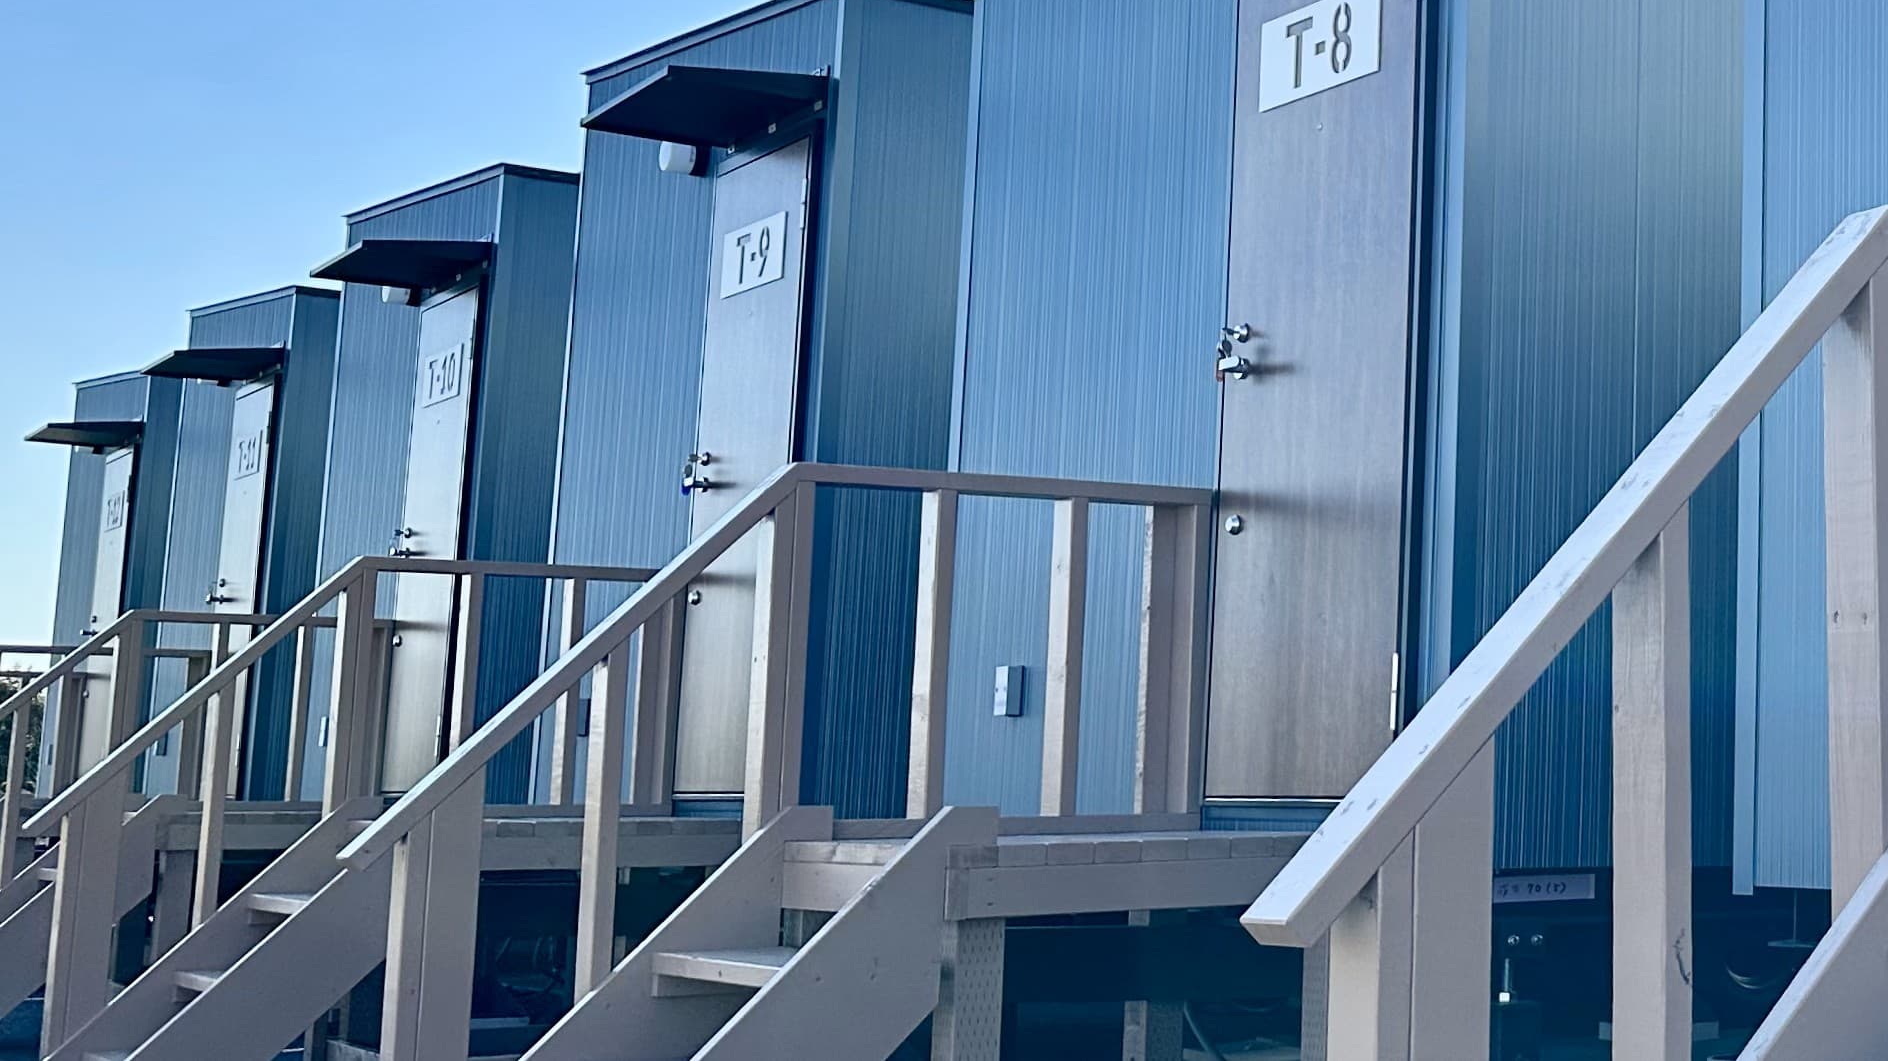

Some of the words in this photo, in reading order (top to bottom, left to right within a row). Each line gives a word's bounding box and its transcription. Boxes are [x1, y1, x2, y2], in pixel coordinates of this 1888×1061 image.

[1286, 2, 1352, 89] T-8
[737, 226, 770, 285] T-9
[429, 352, 455, 400] T-10
[239, 437, 256, 474] T-11
